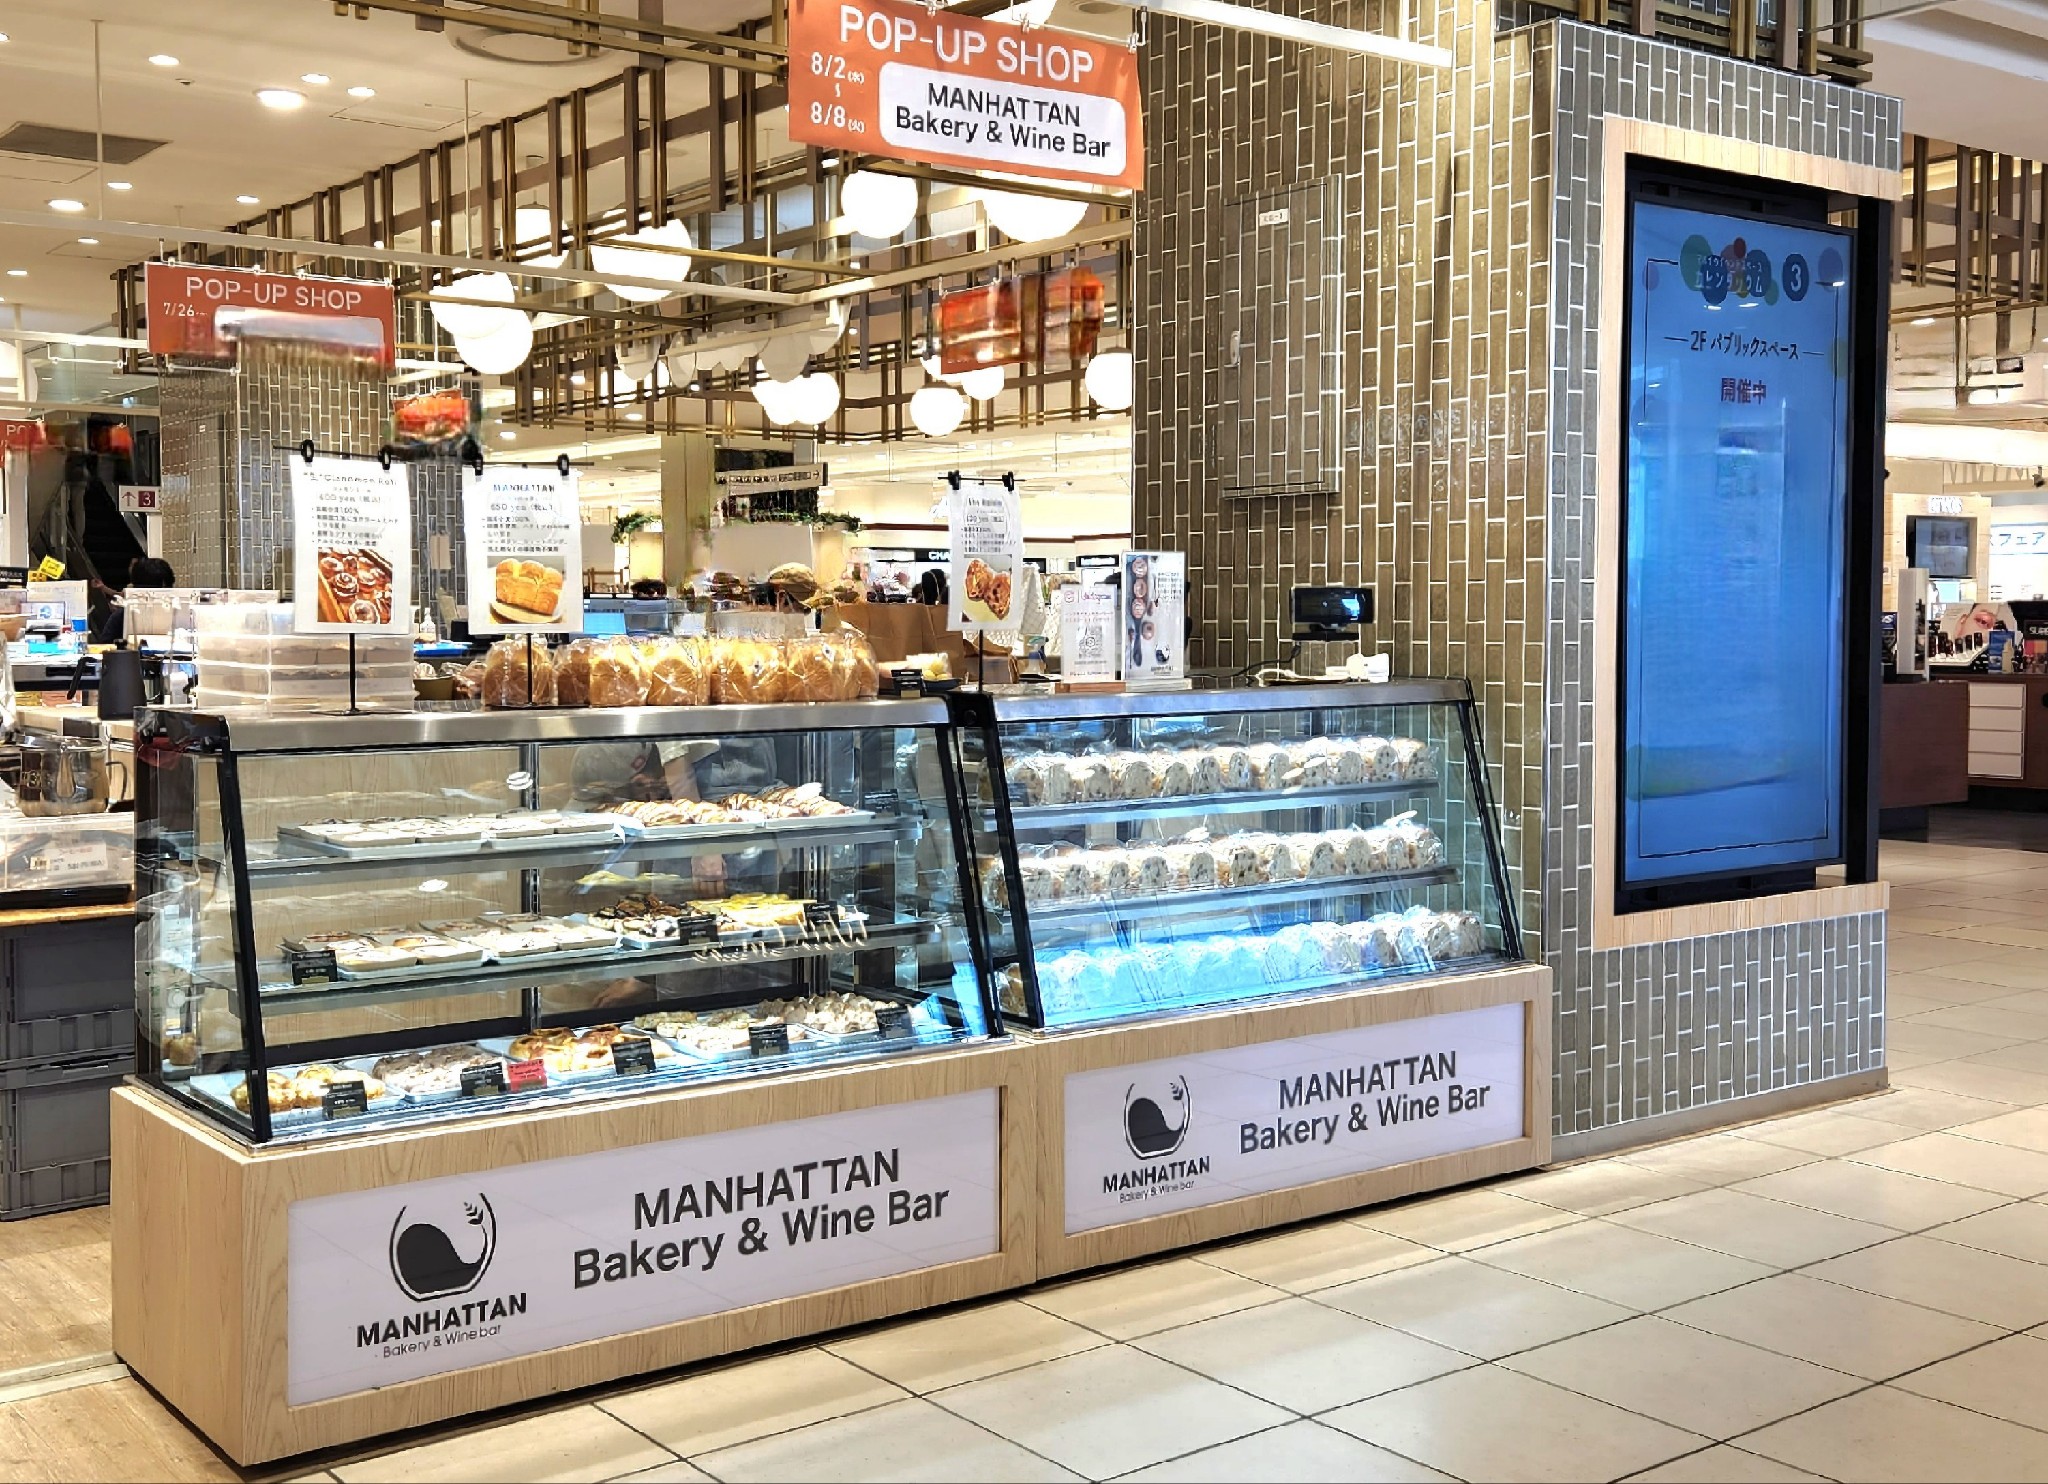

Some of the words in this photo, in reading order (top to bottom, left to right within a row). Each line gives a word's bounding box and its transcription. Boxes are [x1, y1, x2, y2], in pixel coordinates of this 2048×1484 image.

[840, 4, 986, 66] POP-UP
[996, 36, 1094, 83] SHOP
[927, 82, 1080, 128] MANHATTAN
[896, 106, 978, 144] Bakery
[986, 121, 1003, 143] &
[1010, 123, 1066, 153] Wine
[1072, 133, 1111, 158] Bar
[186, 276, 288, 305] POP-UP
[295, 286, 362, 310] SHOP
[1790, 264, 1802, 292] 3
[1690, 330, 1707, 352] 2F
[1711, 331, 1799, 360] パブリックスペース
[1721, 377, 1767, 405] 開催中
[142, 493, 152, 506] 3
[1279, 1050, 1456, 1110] MANHATTAN
[1240, 1114, 1339, 1154] Bakery
[1347, 1102, 1368, 1133] &
[1377, 1093, 1440, 1127] Wine
[1448, 1084, 1491, 1114] Bar
[634, 1147, 899, 1230] MANHATTAN
[1103, 1155, 1210, 1193] MANHATTAN
[574, 1232, 726, 1289] Bakery
[737, 1217, 769, 1255] &
[782, 1203, 876, 1246] Wine
[888, 1189, 950, 1226] Bar
[356, 1292, 527, 1348] MANHATTAN
[383, 1340, 431, 1359] Bakery
[433, 1335, 442, 1347] &
